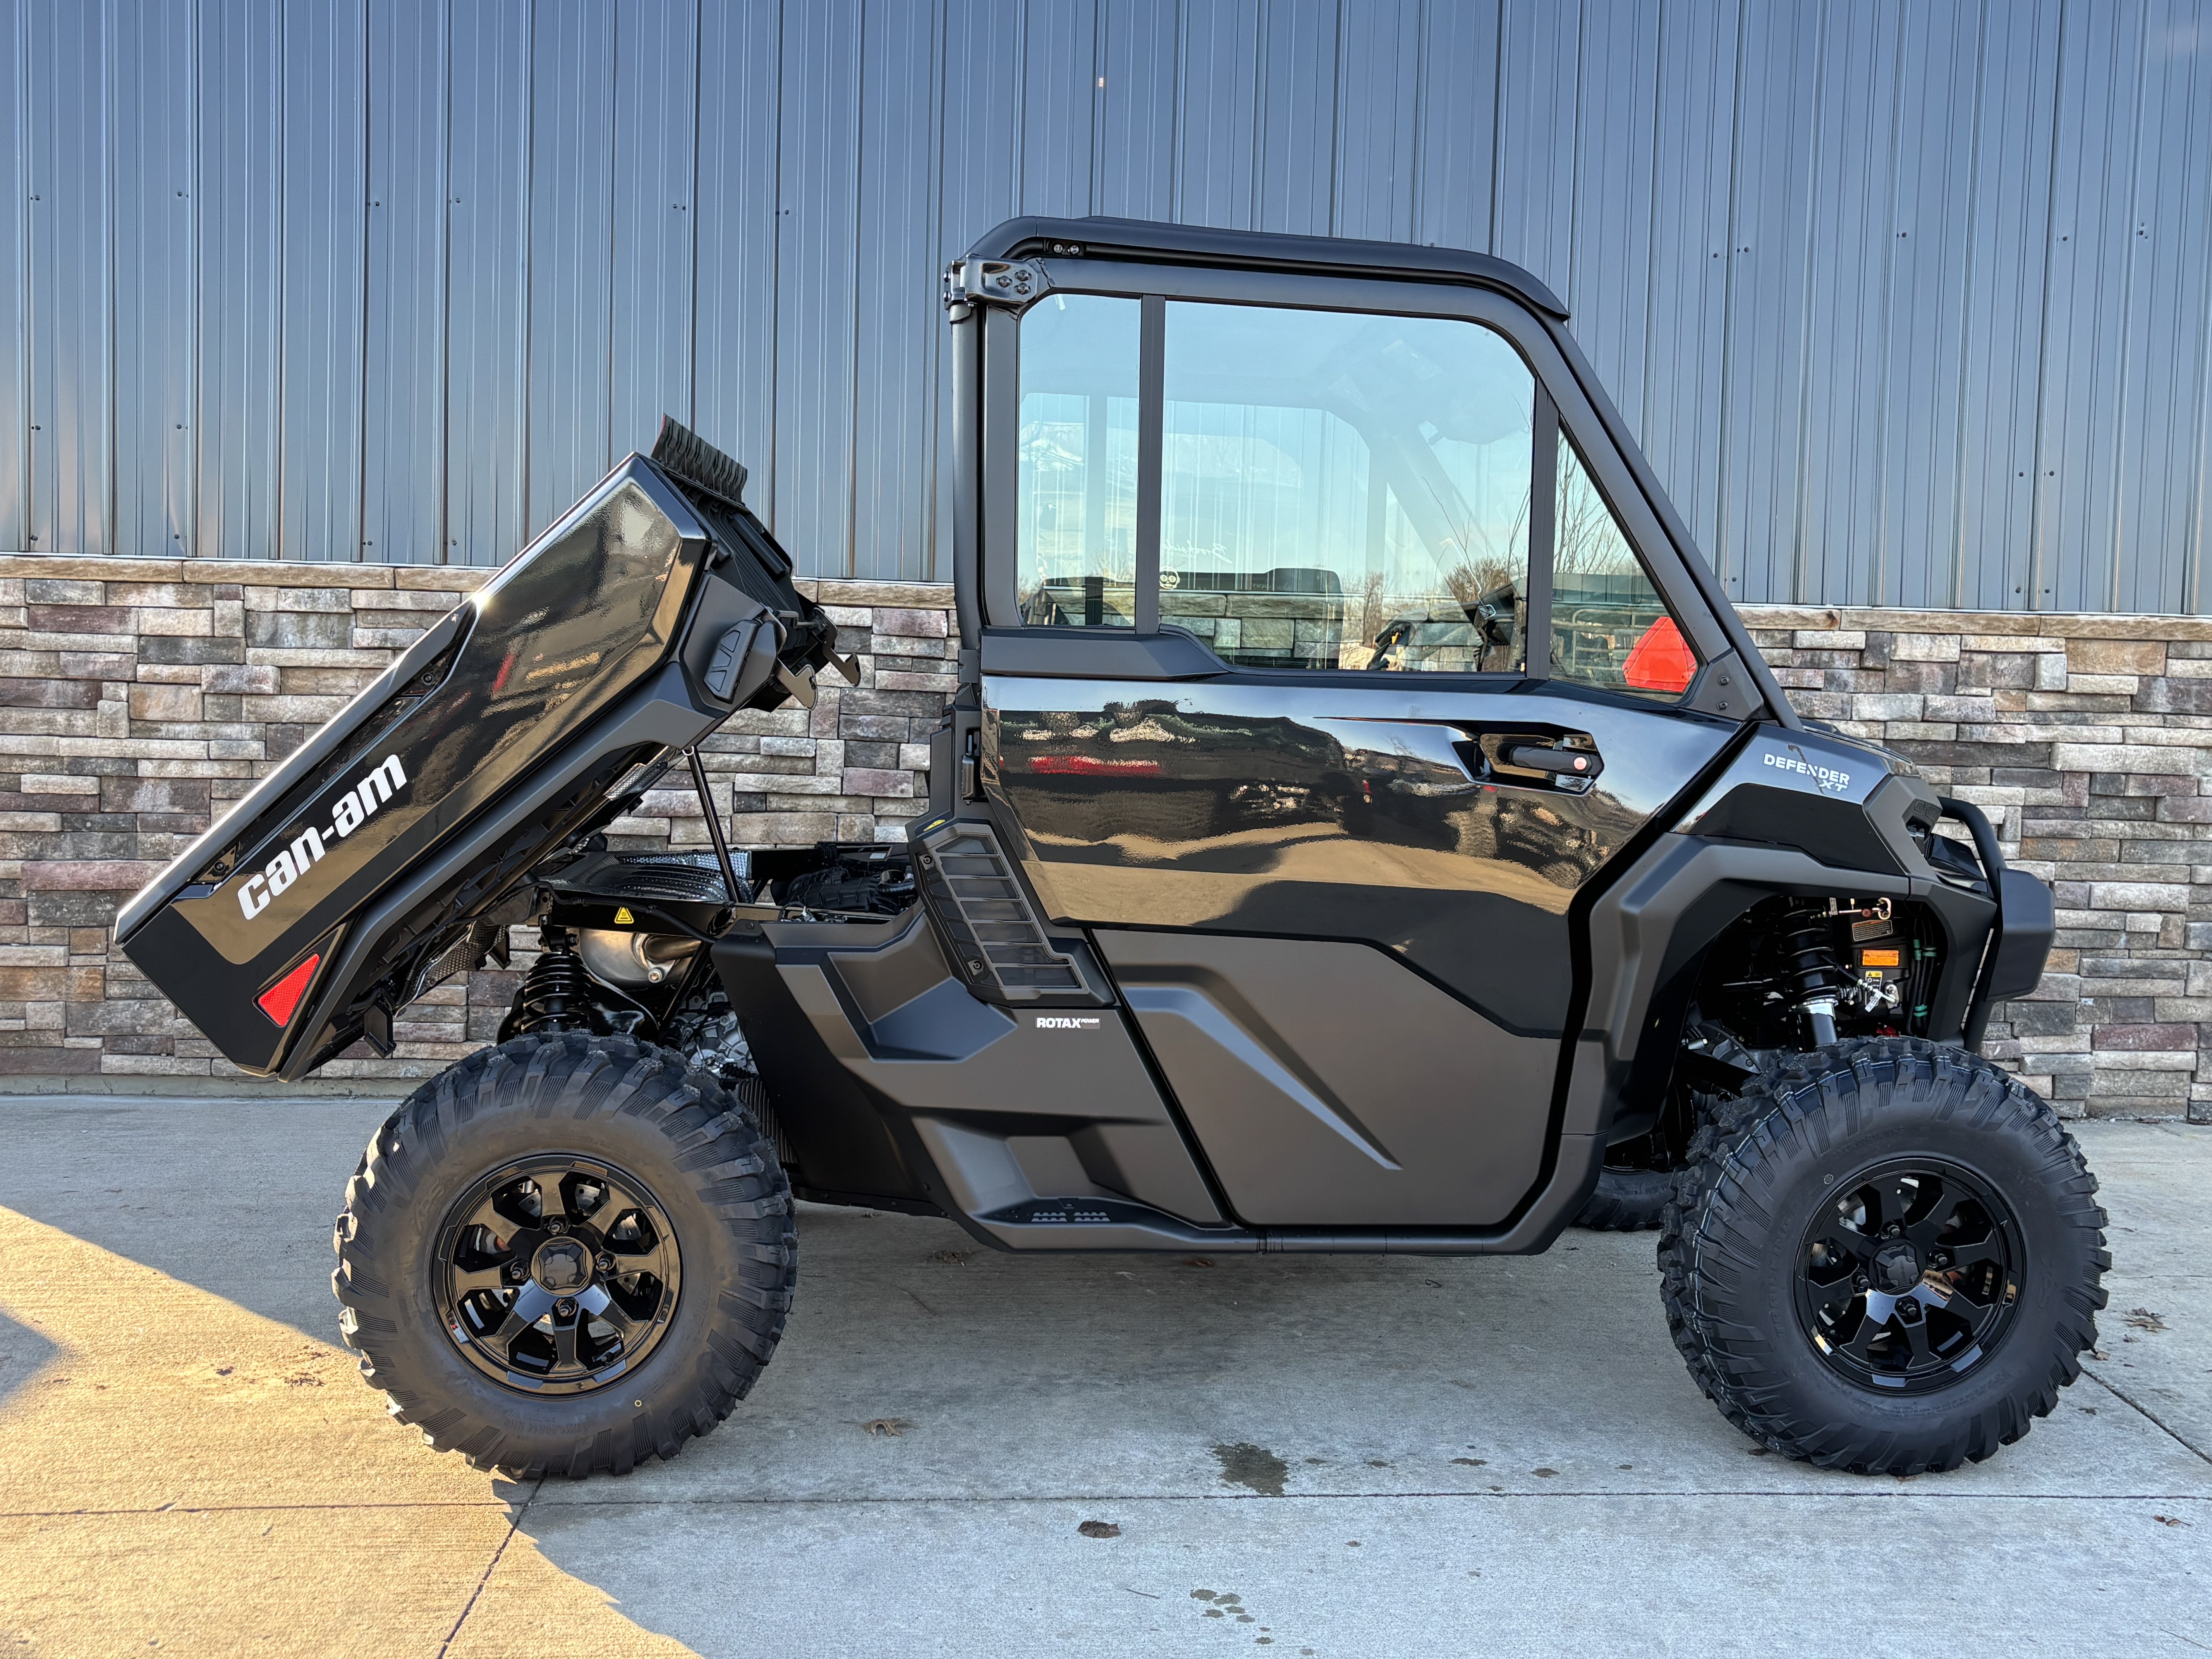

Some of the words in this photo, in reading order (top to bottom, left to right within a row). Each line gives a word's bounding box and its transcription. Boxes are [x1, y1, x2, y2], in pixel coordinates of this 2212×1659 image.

[1764, 753, 1850, 785] DEFENDER
[1819, 780, 1848, 792] XT
[237, 754, 407, 920] can-am
[1036, 1017, 1081, 1029] ROTAX
